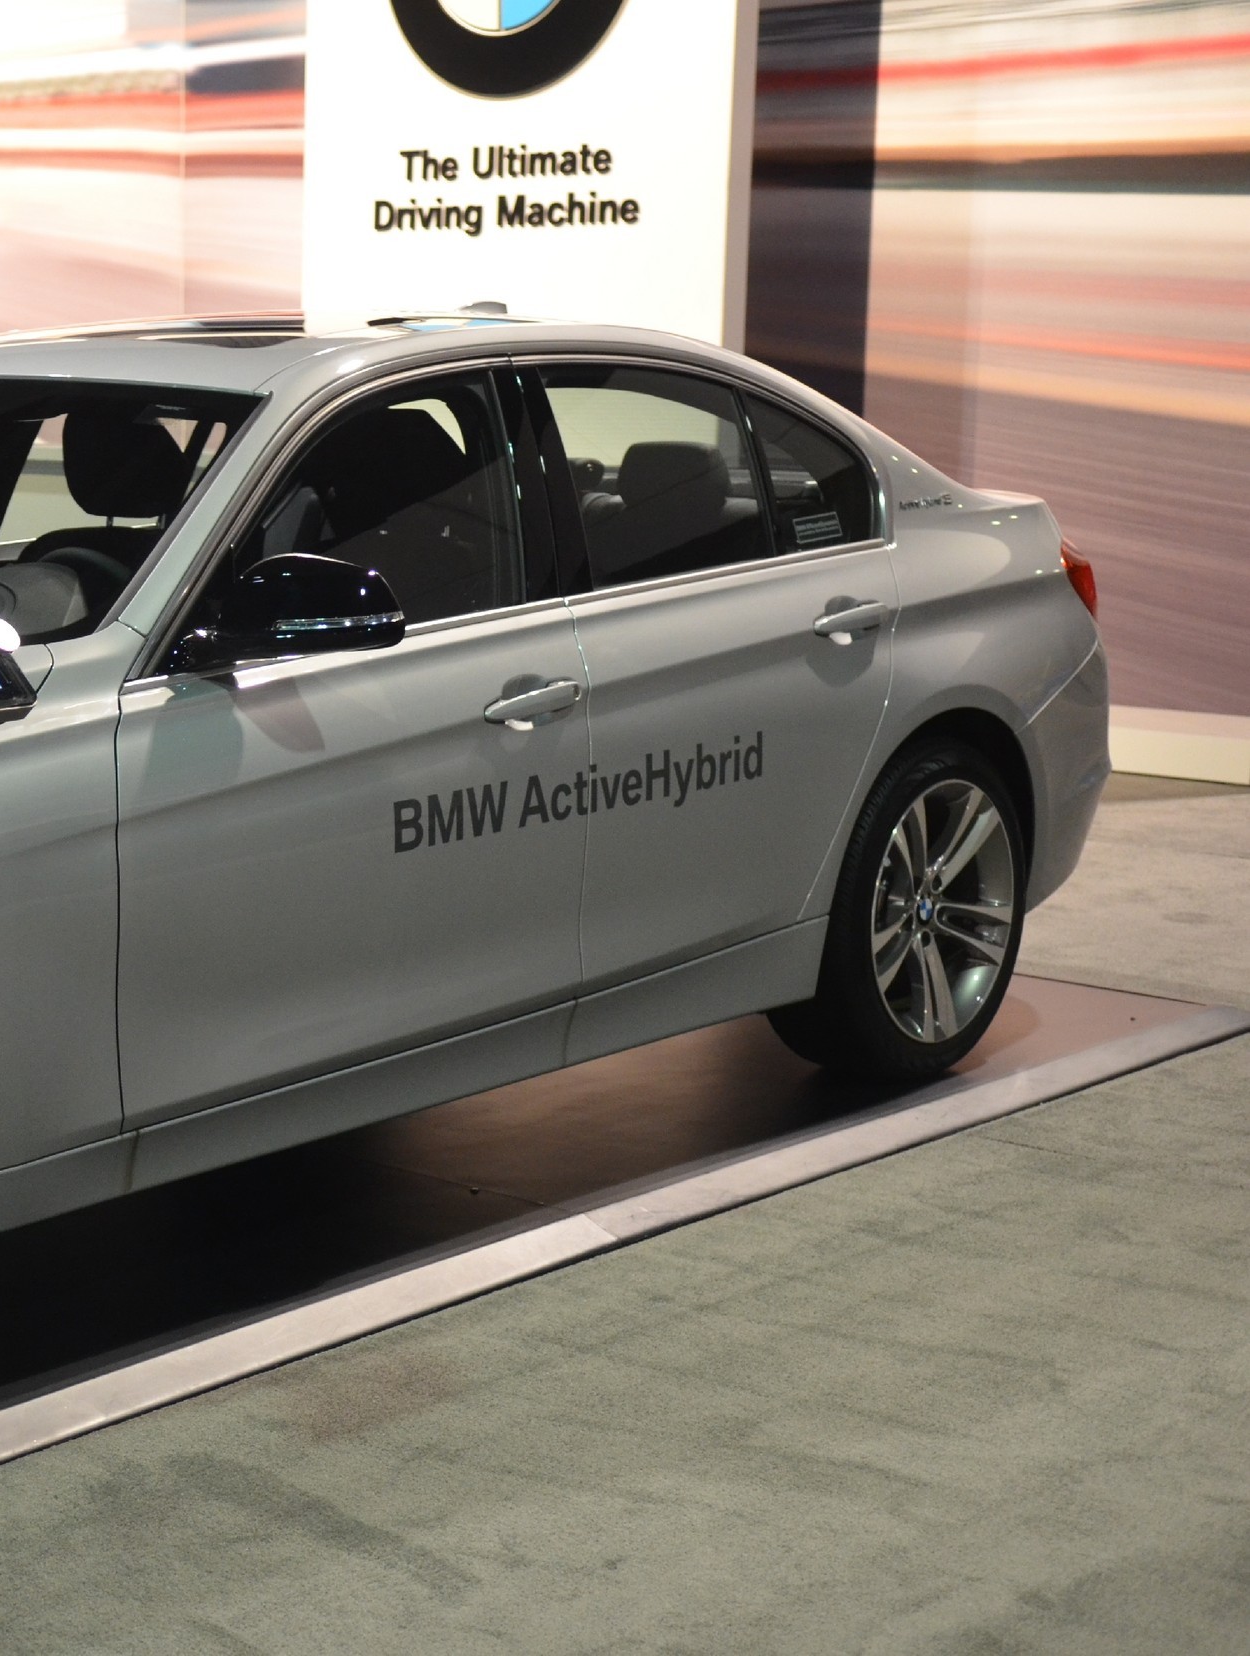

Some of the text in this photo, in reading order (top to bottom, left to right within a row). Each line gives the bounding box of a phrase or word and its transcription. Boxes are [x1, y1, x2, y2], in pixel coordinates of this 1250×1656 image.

[399, 144, 612, 182] The Ultimate
[374, 191, 640, 237] Driving Machine
[393, 731, 763, 854] BMW ActiveHybrid
